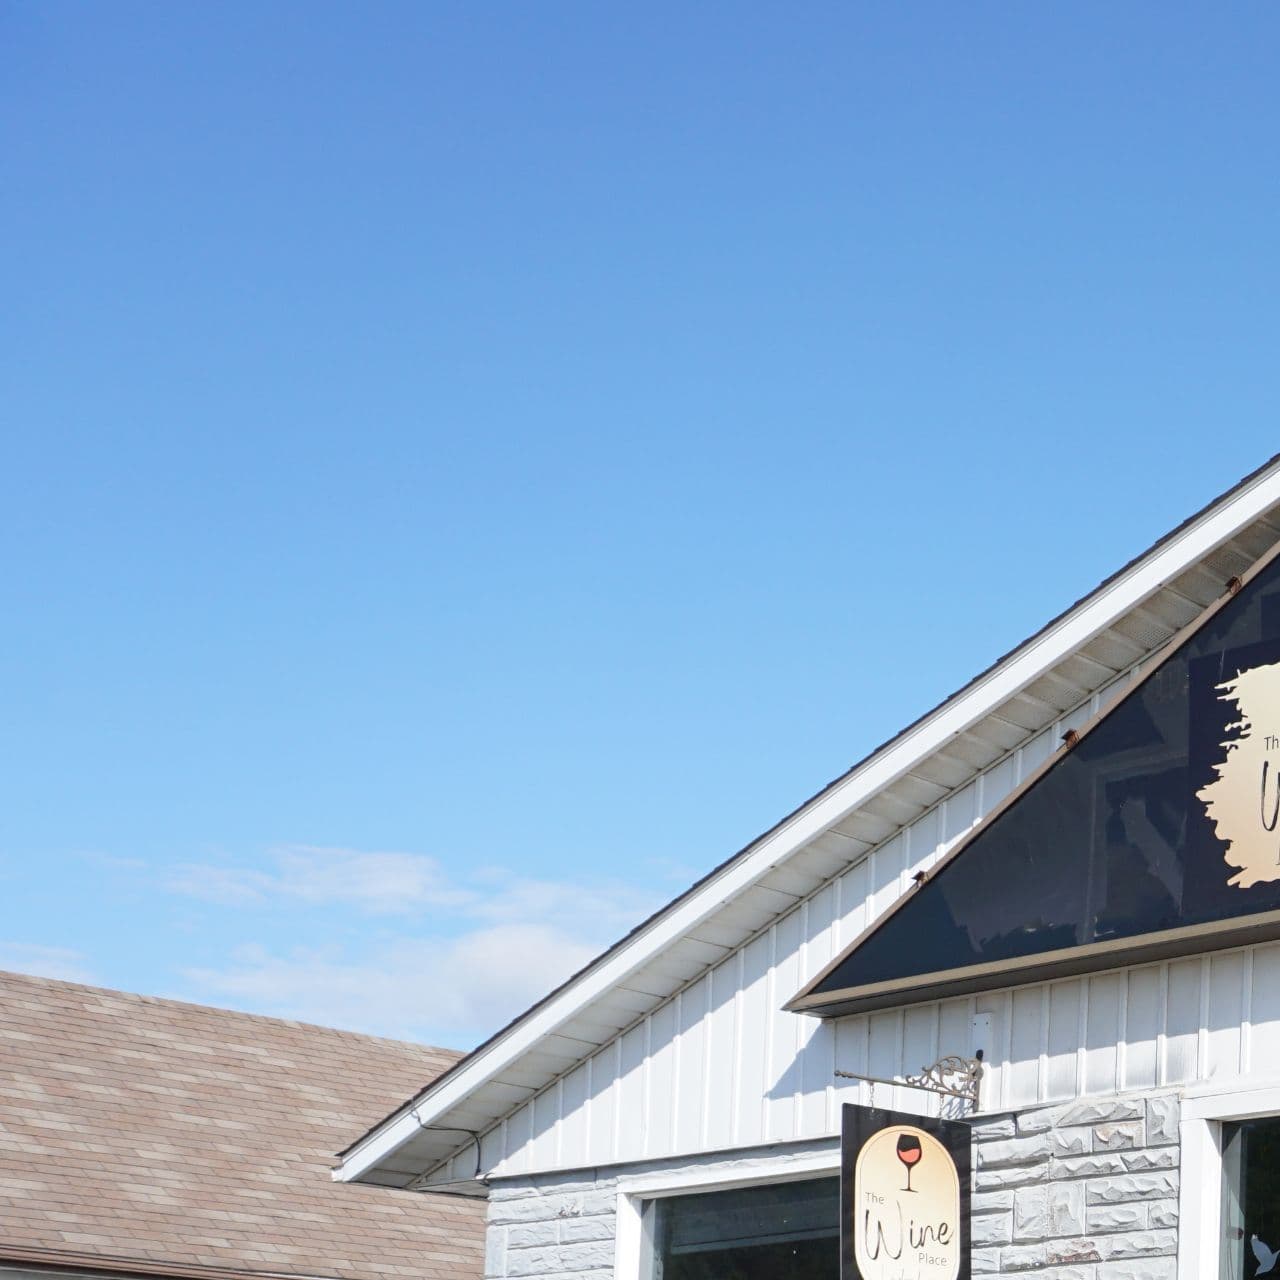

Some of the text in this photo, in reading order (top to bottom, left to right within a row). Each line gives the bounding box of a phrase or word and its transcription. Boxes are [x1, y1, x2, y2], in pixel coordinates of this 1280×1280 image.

[865, 1191, 885, 1205] The
[864, 1199, 955, 1261] Wine
[918, 1252, 948, 1266] Place
